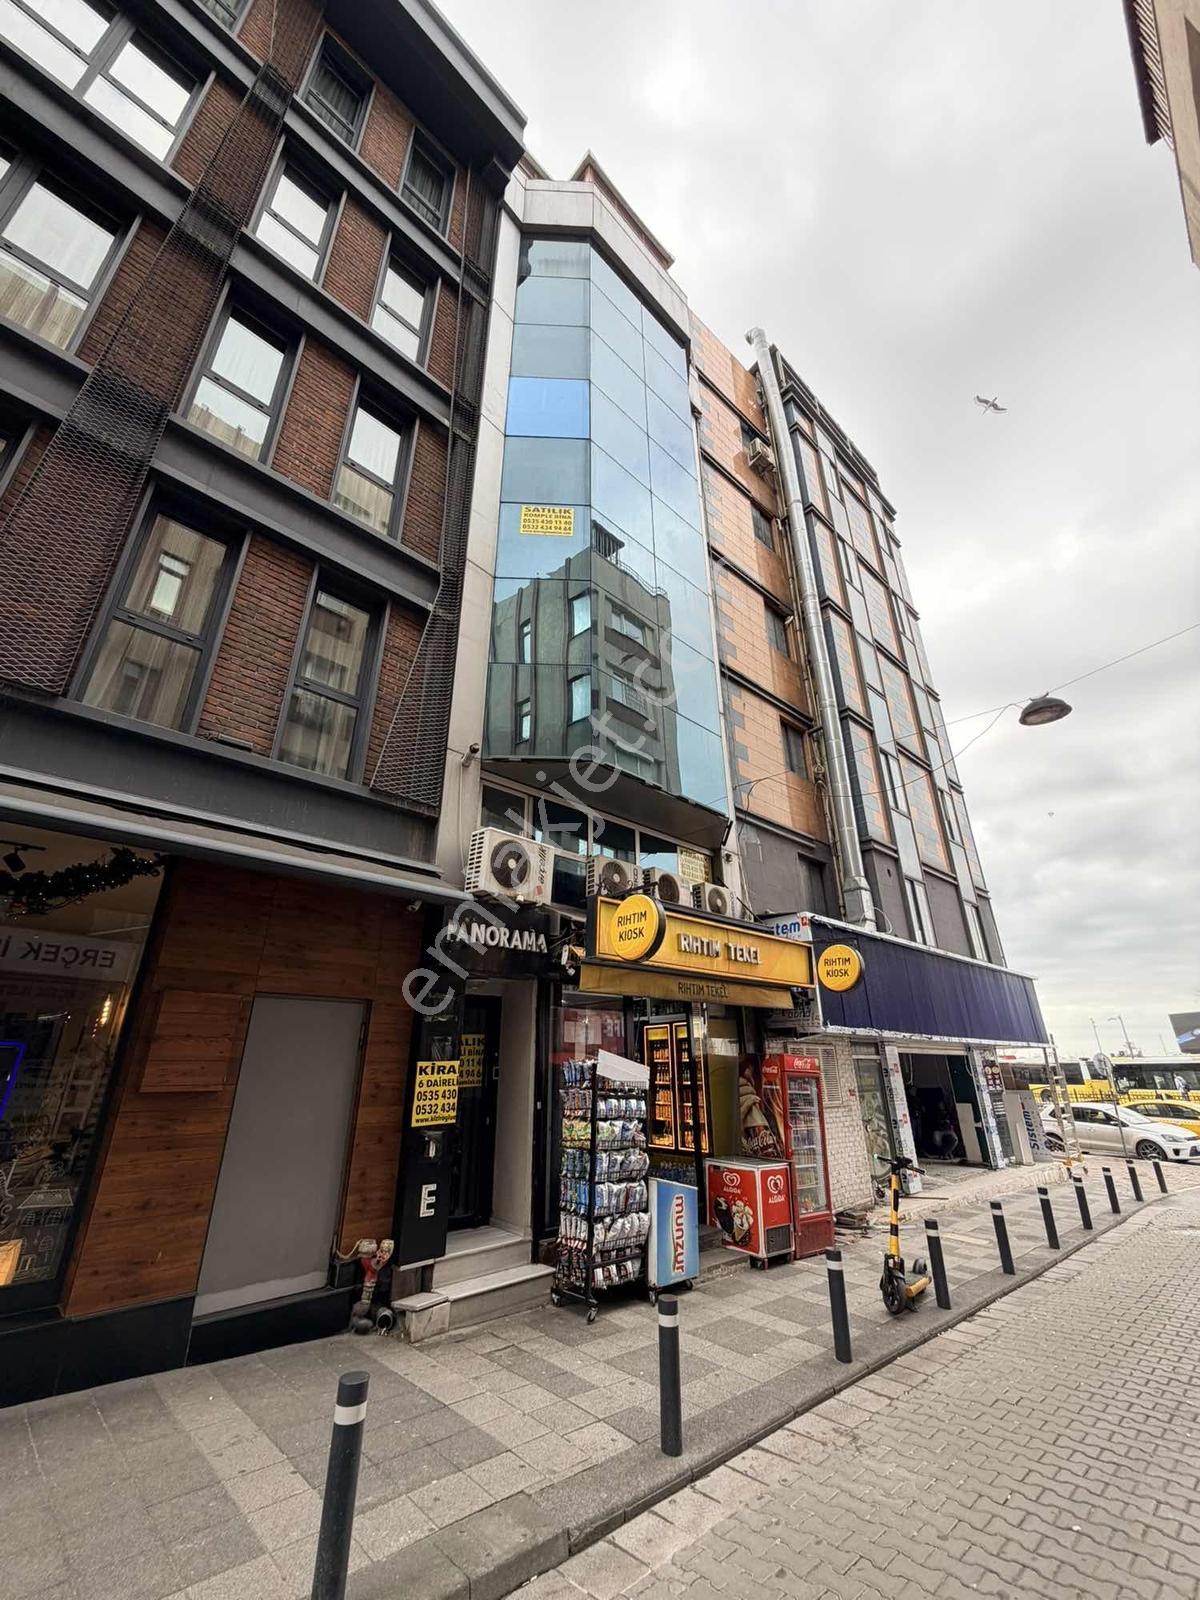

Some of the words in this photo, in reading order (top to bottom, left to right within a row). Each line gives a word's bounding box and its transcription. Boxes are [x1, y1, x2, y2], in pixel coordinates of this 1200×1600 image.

[524, 507, 572, 515] SATILIK
[617, 910, 647, 926] RIHTIM
[618, 926, 645, 942] KİOSK
[775, 921, 801, 935] tem
[447, 919, 548, 953] PANORAMA
[678, 933, 721, 957] RIHTIM
[727, 943, 763, 965] TEKEL
[824, 957, 851, 967] RIHTIM
[826, 968, 850, 978] KİOSK
[678, 982, 705, 996] RIHTIM
[705, 984, 728, 998] TEKEL
[418, 1063, 457, 1076] KİRA
[418, 1080, 424, 1088] 6
[416, 1090, 439, 1102] 0535
[441, 1089, 457, 1099] 430
[415, 1103, 438, 1115] 0532
[440, 1102, 456, 1113] 434
[420, 1183, 437, 1218] E
[674, 1194, 685, 1274] munzur
